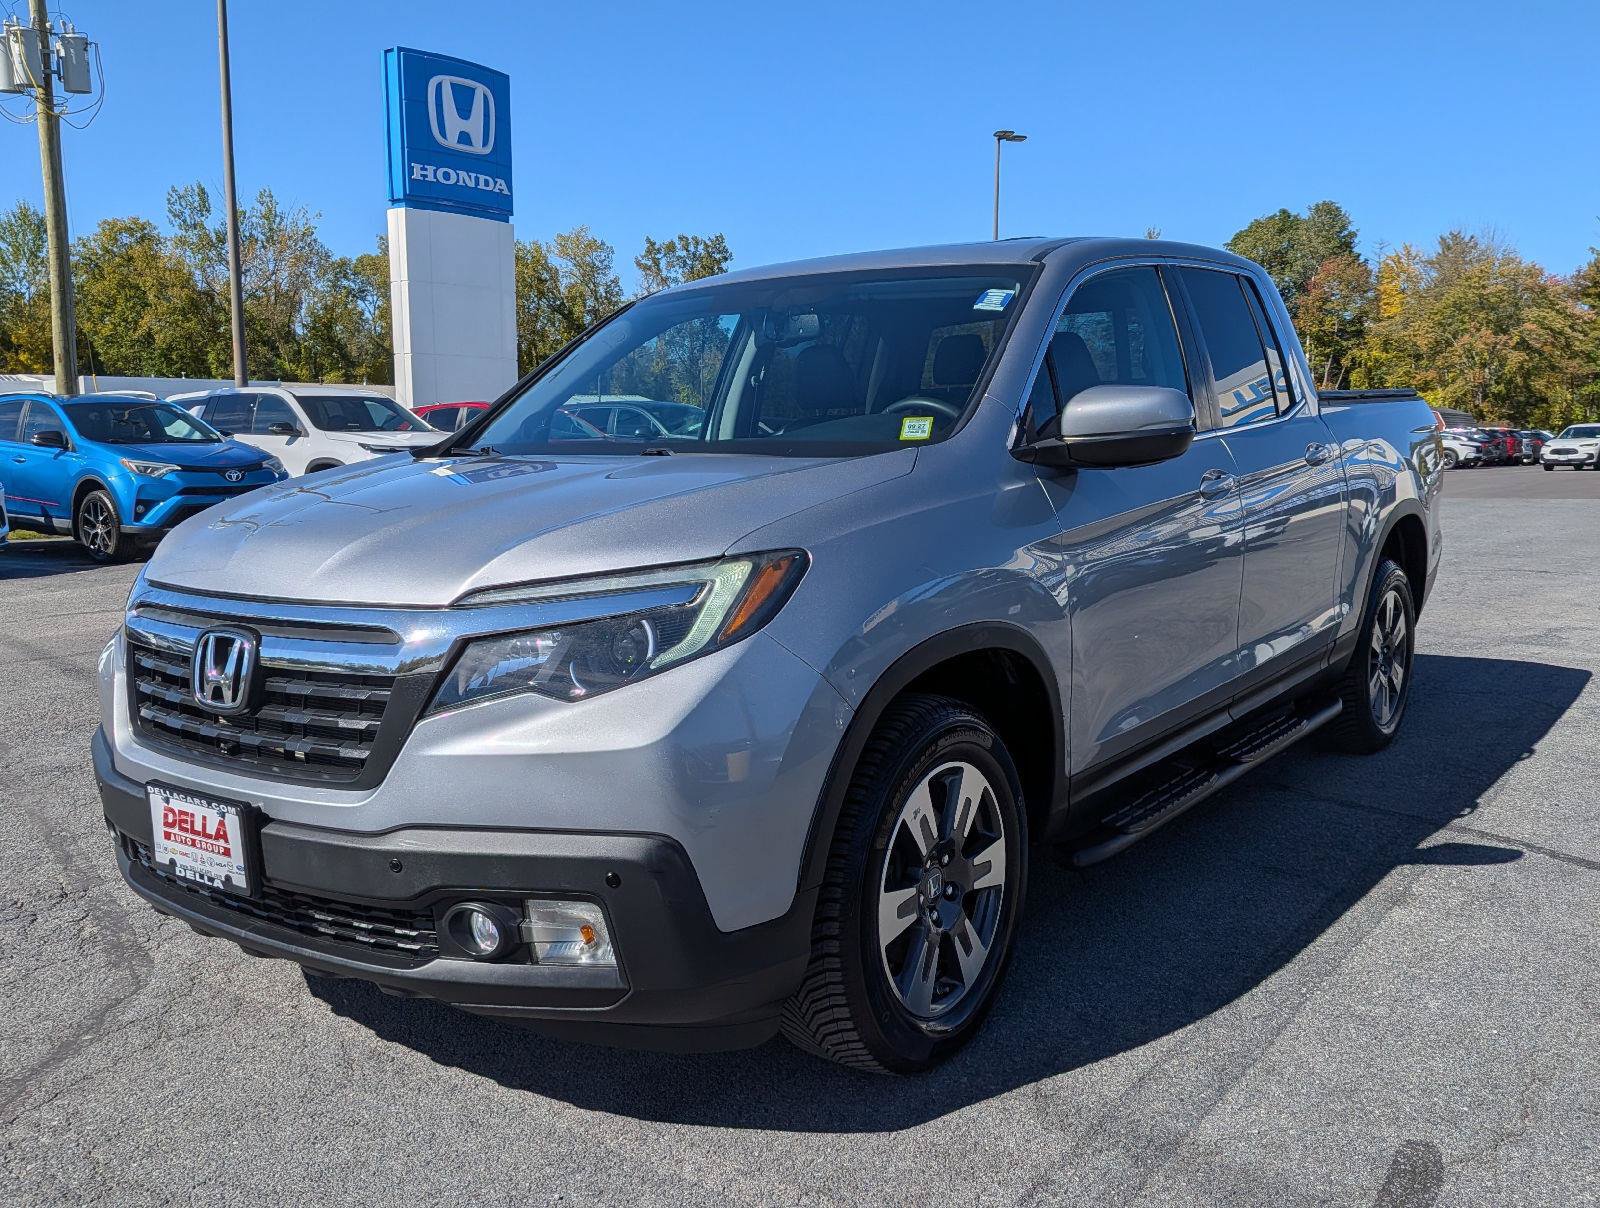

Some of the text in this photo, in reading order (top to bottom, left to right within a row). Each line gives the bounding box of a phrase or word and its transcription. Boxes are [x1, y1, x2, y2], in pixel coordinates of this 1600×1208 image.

[411, 162, 511, 195] HONDA
[147, 785, 237, 815] DELLACARS.COM
[163, 806, 230, 845] DELLA
[170, 834, 225, 855] AUTO GROUP
[175, 866, 224, 889] DELLA
